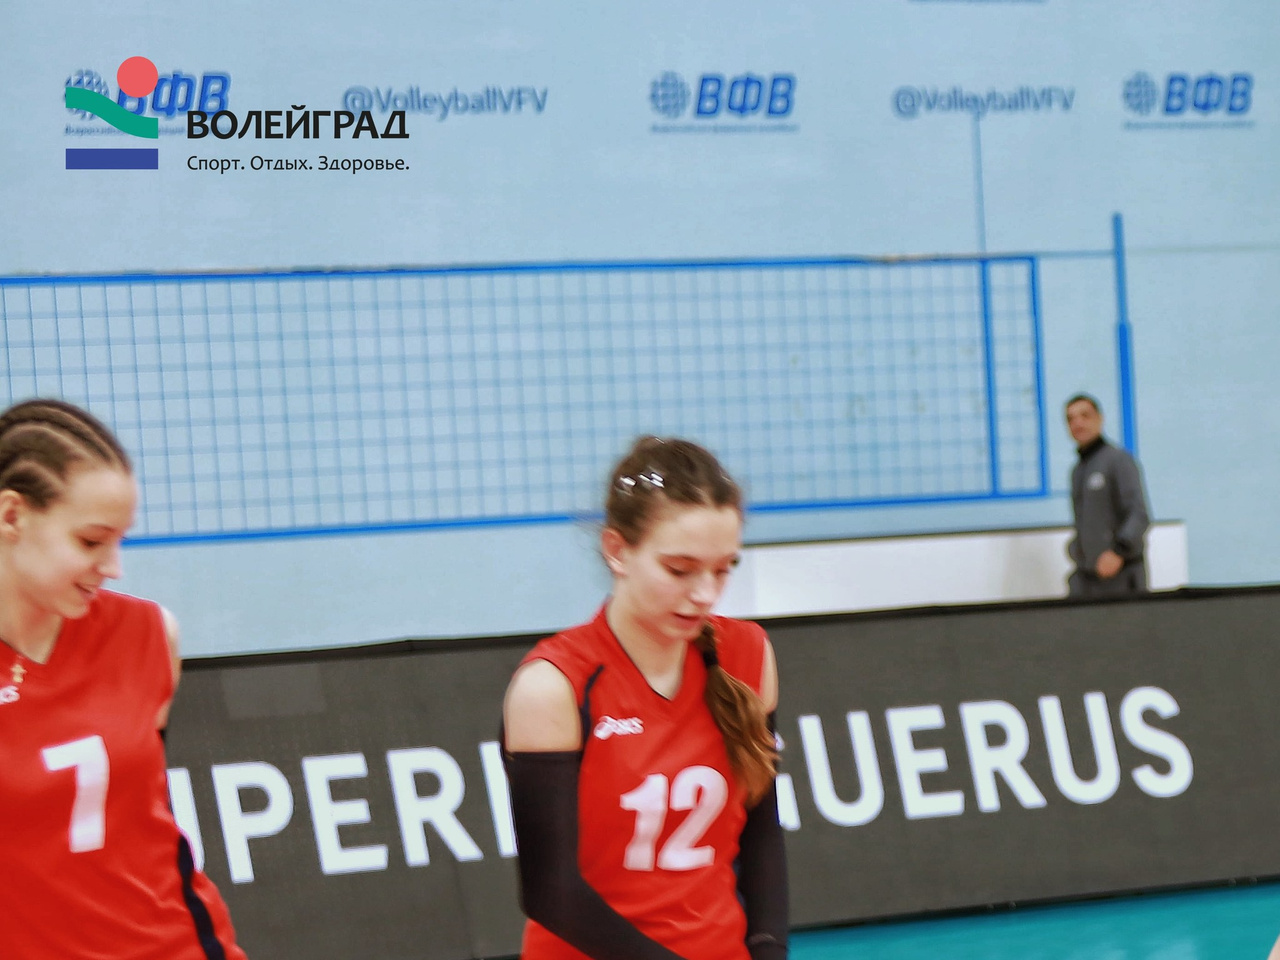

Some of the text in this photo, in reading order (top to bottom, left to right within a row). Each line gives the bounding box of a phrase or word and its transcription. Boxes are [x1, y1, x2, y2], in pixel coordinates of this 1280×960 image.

[343, 84, 548, 121] @VolleyballVFV
[697, 73, 796, 117] ВФВ
[1163, 73, 1254, 116] ВФВ
[40, 735, 110, 854] 7
[621, 765, 729, 872] 12
